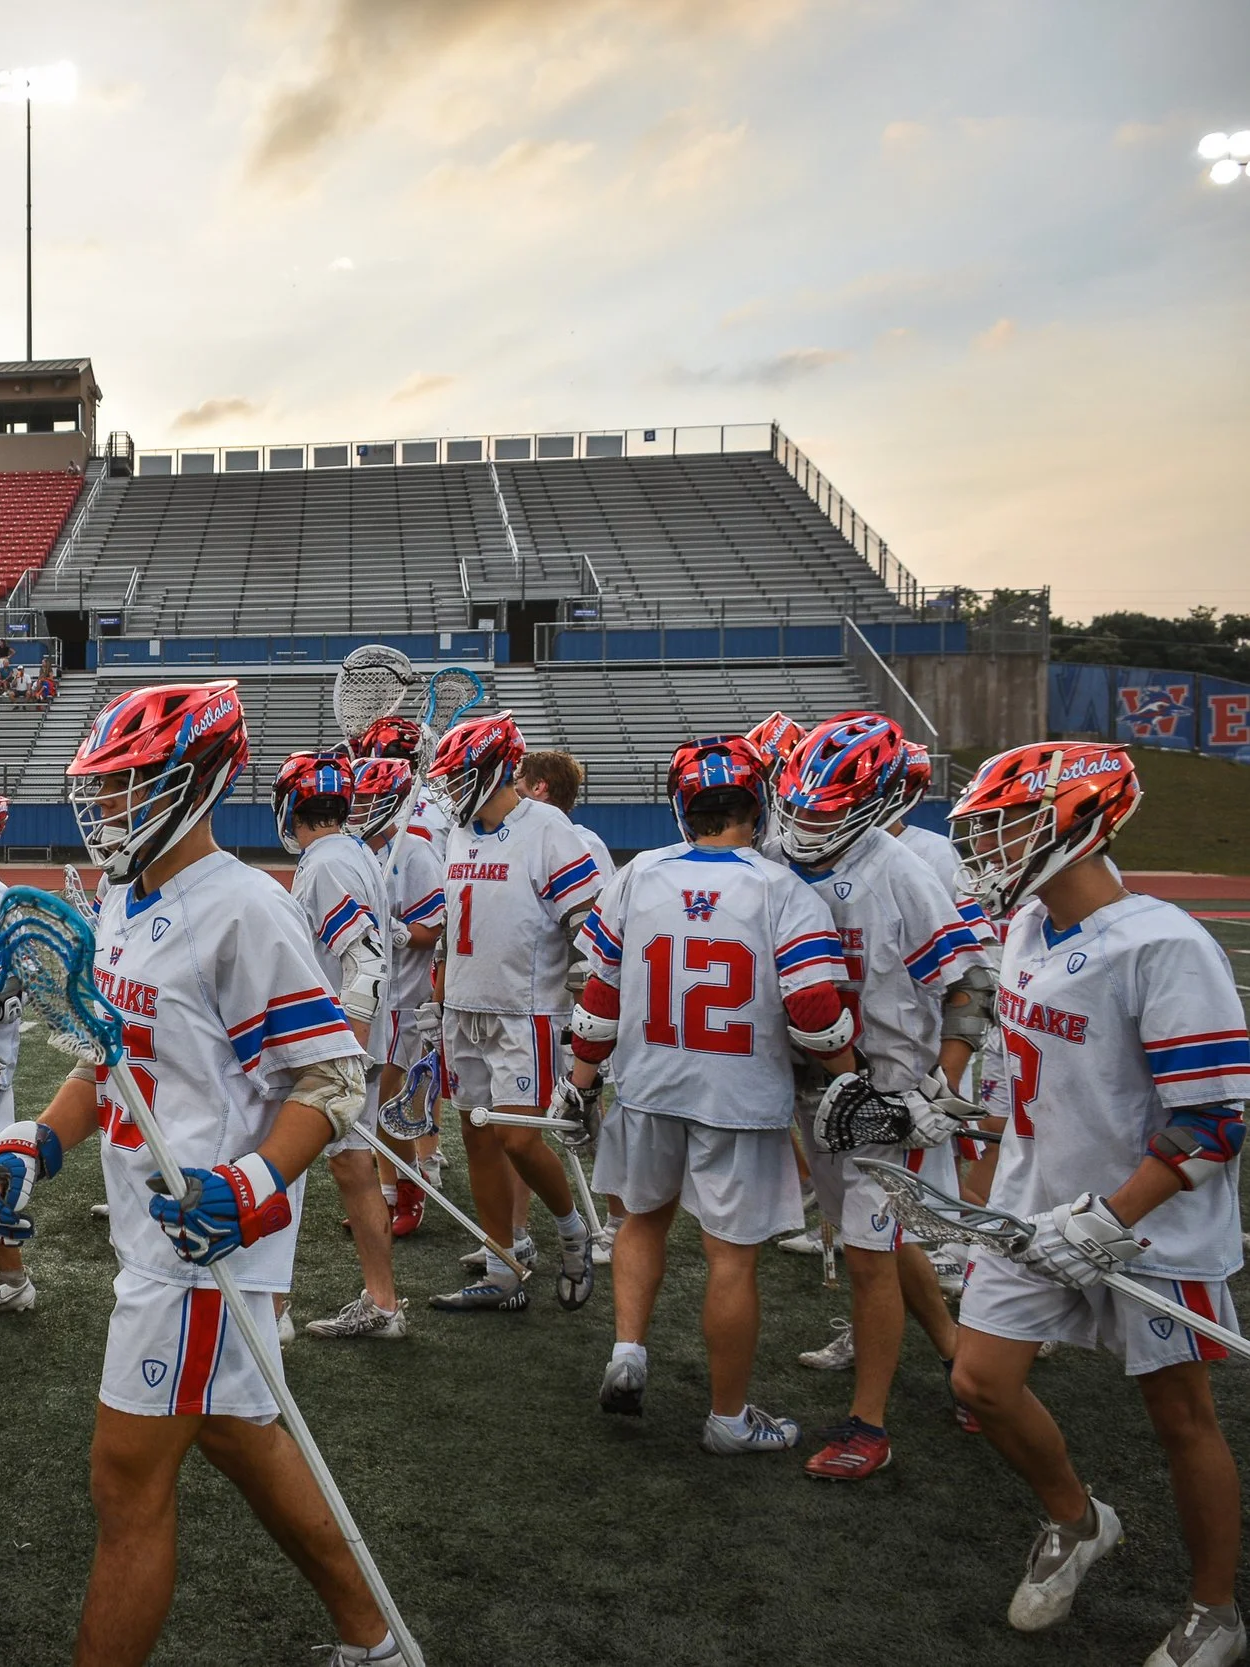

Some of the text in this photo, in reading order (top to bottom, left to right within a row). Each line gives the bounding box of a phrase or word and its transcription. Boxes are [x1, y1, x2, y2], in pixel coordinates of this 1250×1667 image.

[1208, 694, 1250, 746] E
[1021, 752, 1122, 793] Wstlake
[456, 883, 474, 957] 1
[682, 888, 722, 922] W
[641, 933, 757, 1057] 12
[226, 1164, 250, 1208] ESTLAKE
[1076, 1238, 1120, 1272] STX
